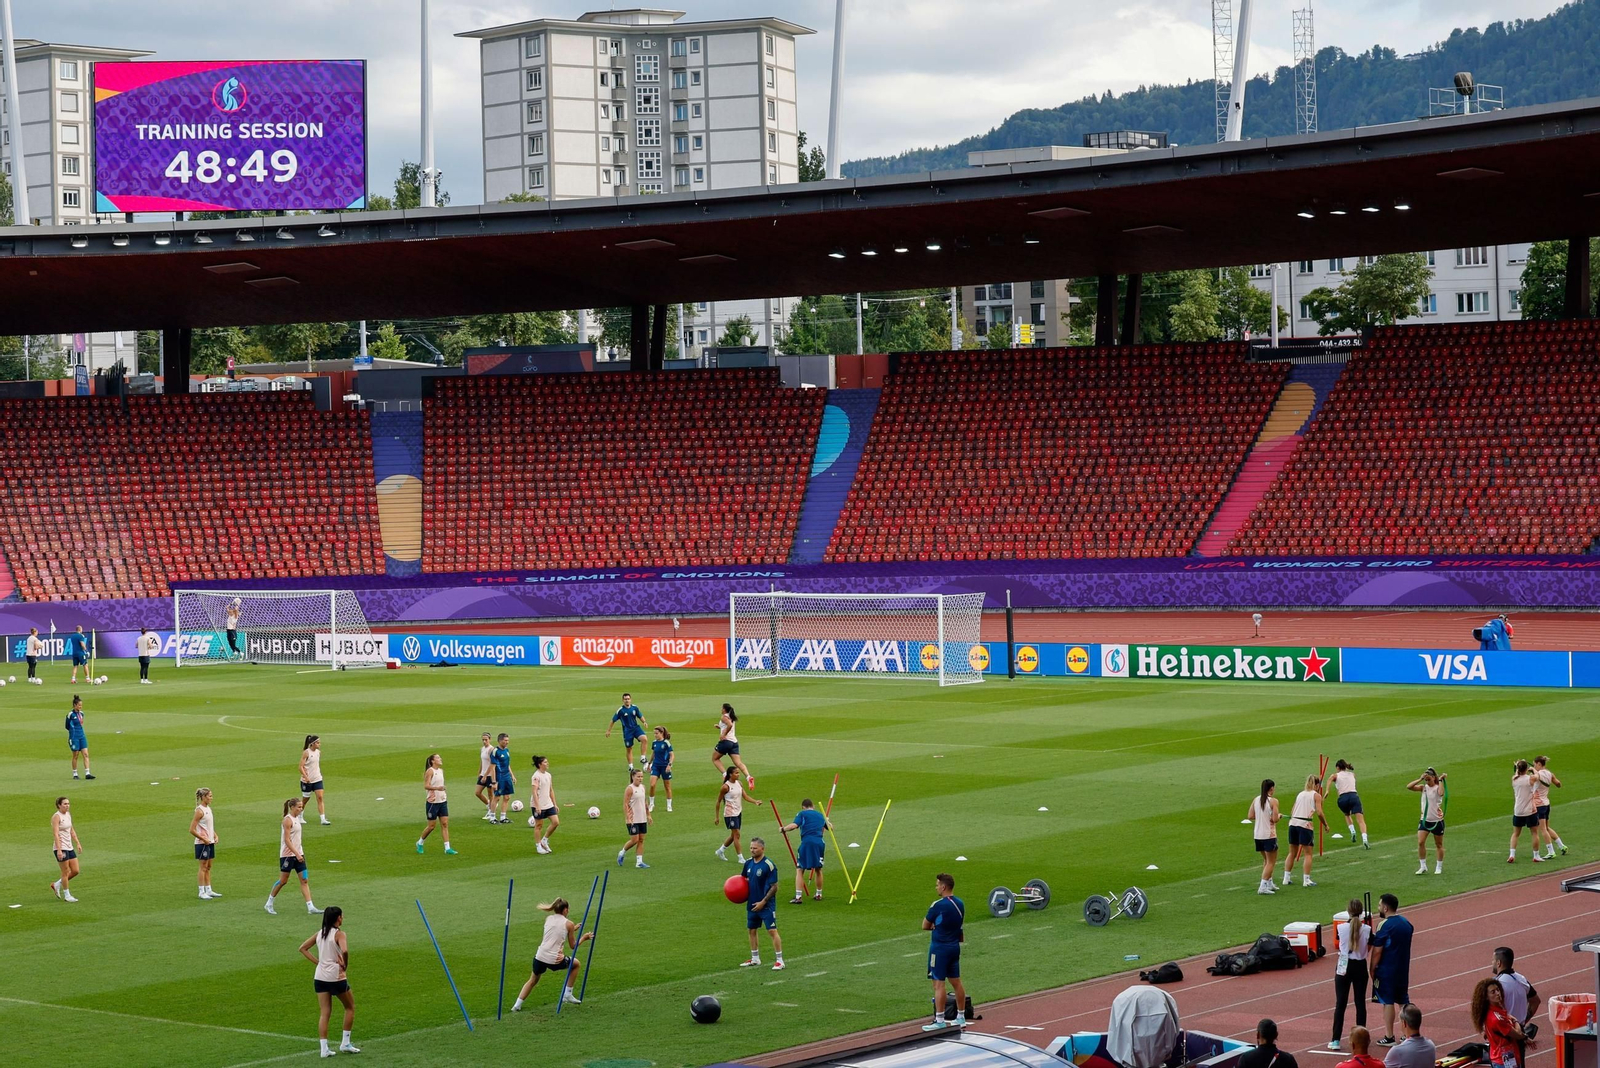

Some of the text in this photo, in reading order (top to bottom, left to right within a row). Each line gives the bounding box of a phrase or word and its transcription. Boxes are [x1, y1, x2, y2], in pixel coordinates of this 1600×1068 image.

[135, 122, 323, 140] TRAINING SESSION
[164, 149, 298, 183] 48:49
[228, 358, 234, 368] C
[1184, 561, 1246, 570] UEFA
[1436, 560, 1600, 568] SWITZERLAND
[524, 574, 620, 582] SUMMIT
[250, 638, 310, 654] HUBLOT
[321, 640, 382, 656] HUBLOT
[429, 640, 525, 662] Volkswagen
[573, 638, 634, 654] amazon
[651, 639, 714, 655] amazon
[734, 638, 779, 669] AXA
[790, 640, 842, 670] AXA
[852, 640, 906, 672] AXA
[1136, 647, 1296, 679] Heineken
[1418, 654, 1488, 680] VISA
